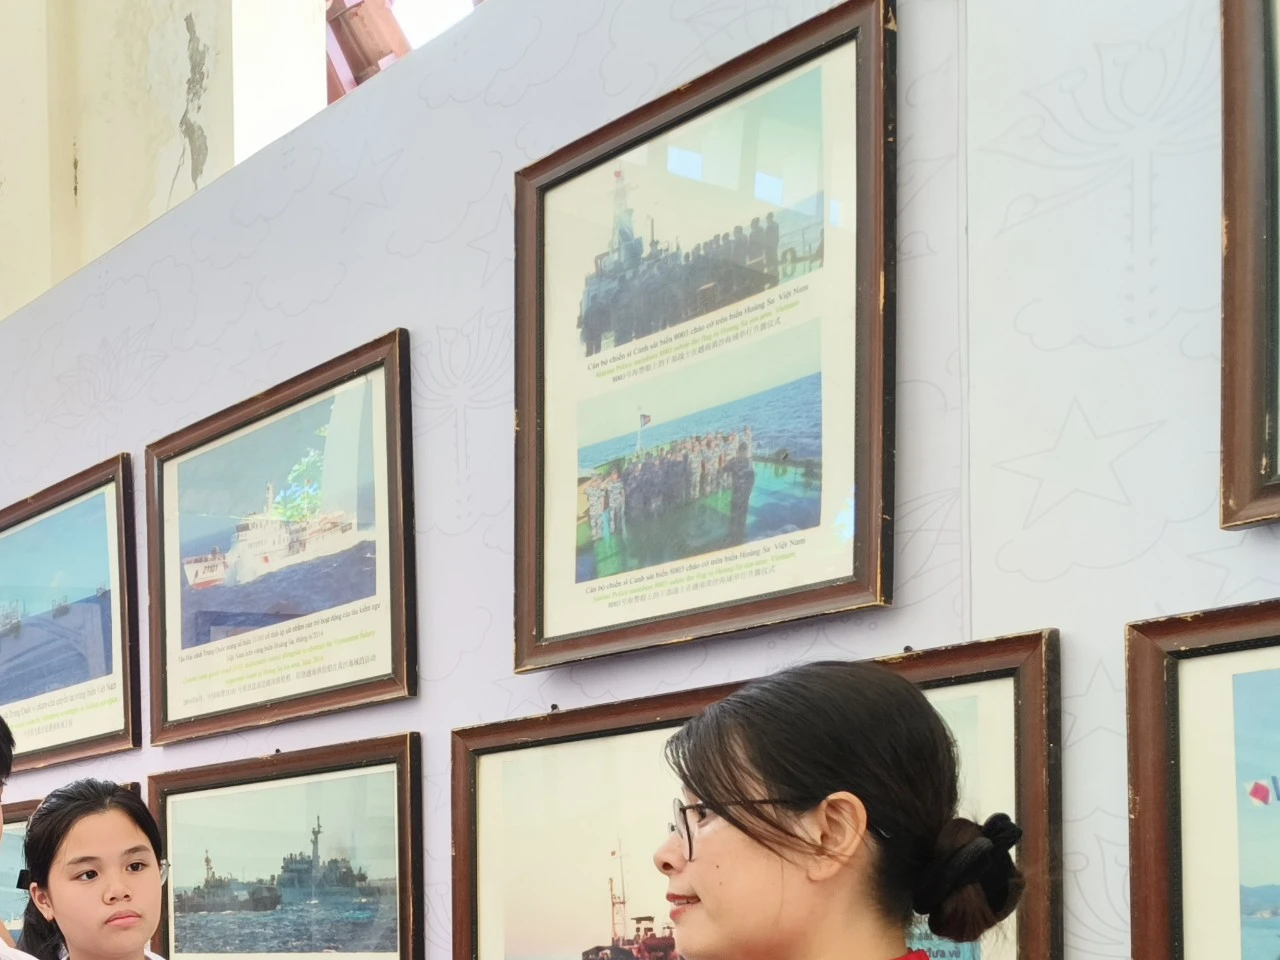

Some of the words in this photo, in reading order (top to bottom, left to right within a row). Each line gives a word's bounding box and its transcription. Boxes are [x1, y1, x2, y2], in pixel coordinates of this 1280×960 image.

[778, 291, 792, 301] Việt
[793, 284, 809, 295] Nam
[774, 541, 787, 550] Việt
[790, 538, 805, 546] Nam
